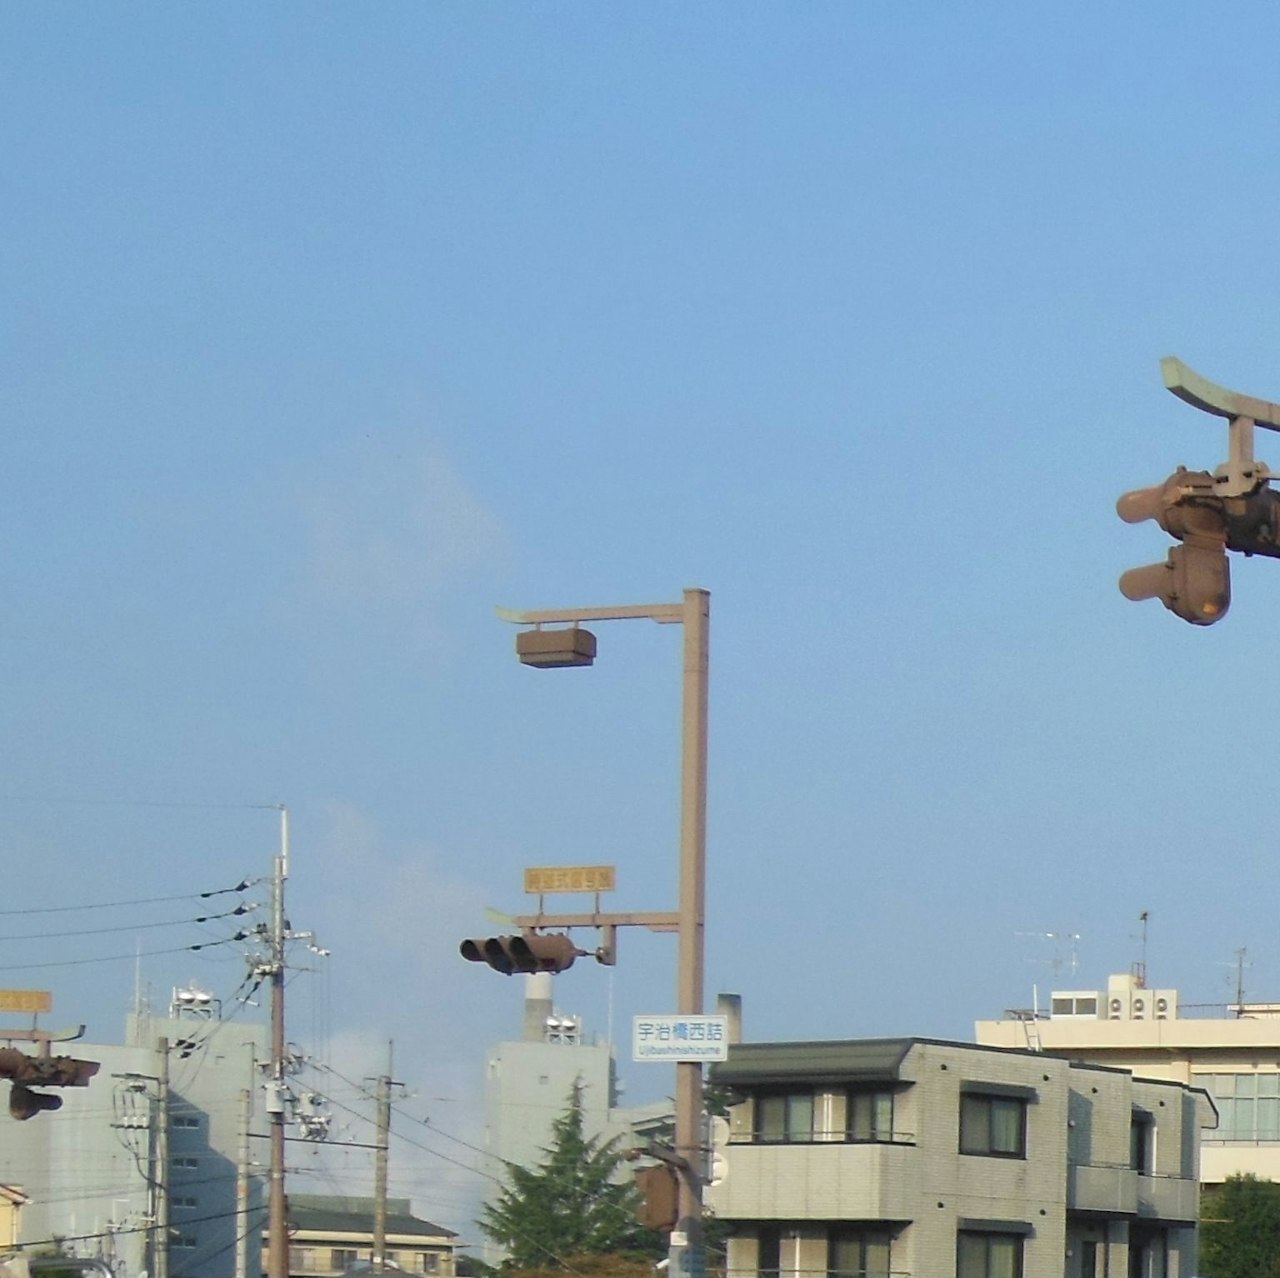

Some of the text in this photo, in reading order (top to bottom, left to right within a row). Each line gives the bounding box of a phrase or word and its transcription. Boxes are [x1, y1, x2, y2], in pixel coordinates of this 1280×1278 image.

[638, 1022, 722, 1041] 宇治橋西詰
